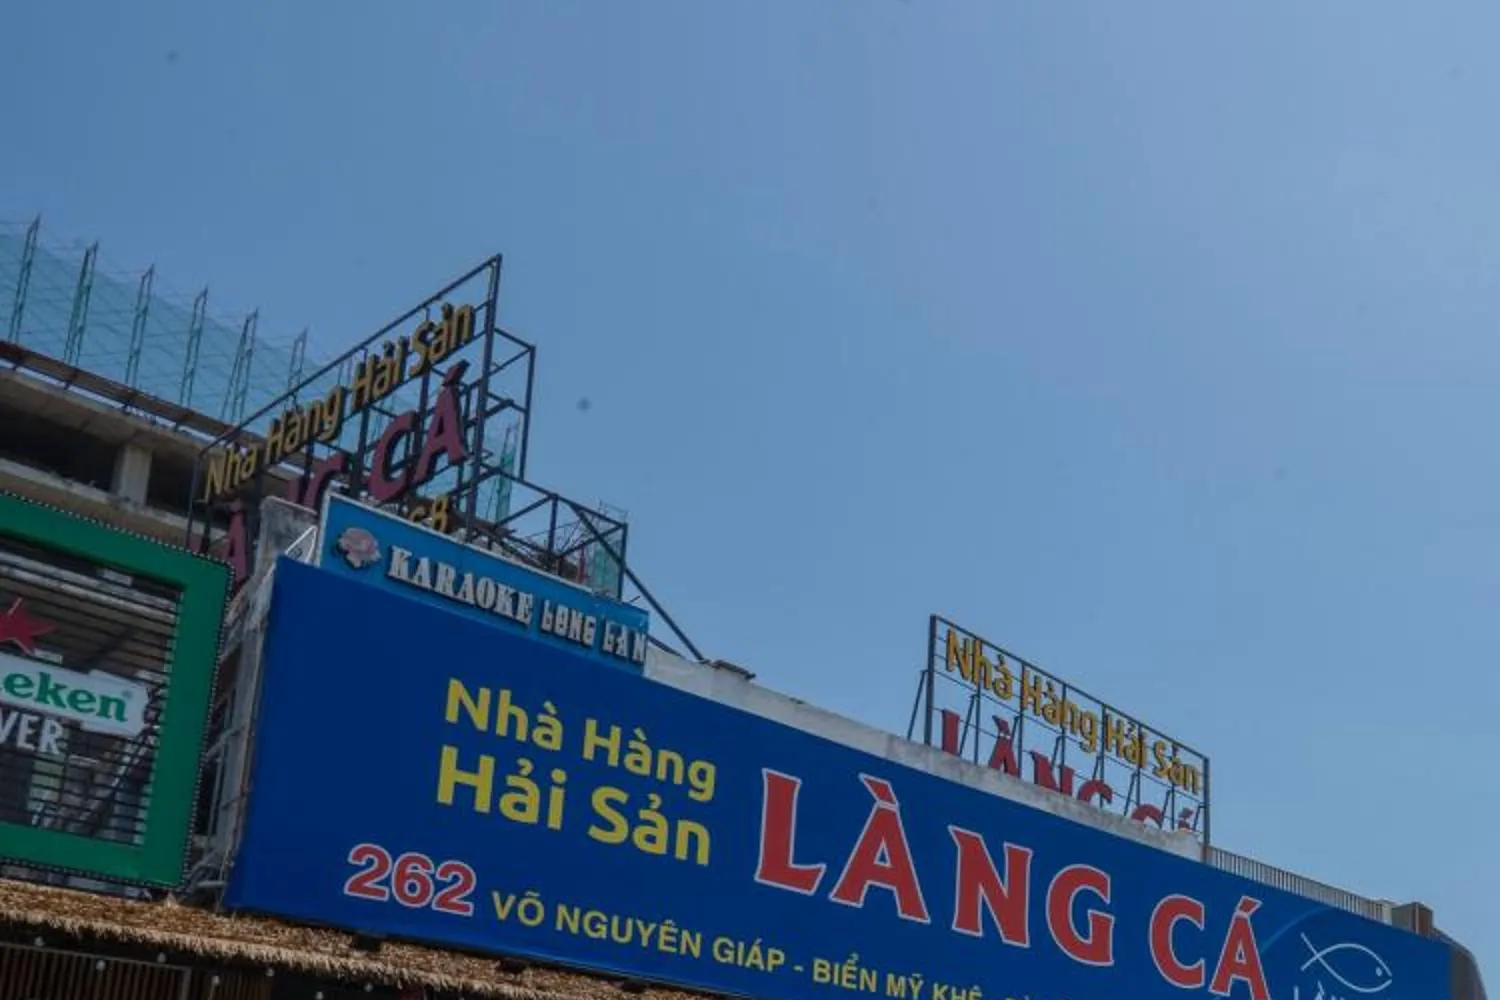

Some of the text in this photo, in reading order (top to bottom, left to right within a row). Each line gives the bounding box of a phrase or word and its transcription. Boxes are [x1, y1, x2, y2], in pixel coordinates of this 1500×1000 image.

[387, 545, 534, 628] KARAOKE
[2, 671, 128, 722] eken
[445, 678, 717, 801] Nhà Hàng
[945, 628, 1199, 795] Nhà Hàng Hải Sản
[437, 744, 712, 867] Hải Sản
[344, 843, 477, 916] 262
[754, 767, 1116, 967] LÀNG
[492, 889, 545, 927] VÕ
[555, 903, 702, 958] NGUYÊN
[712, 938, 785, 973] GIÁP
[813, 952, 877, 993] BIỂN
[885, 972, 924, 1000] MỸ
